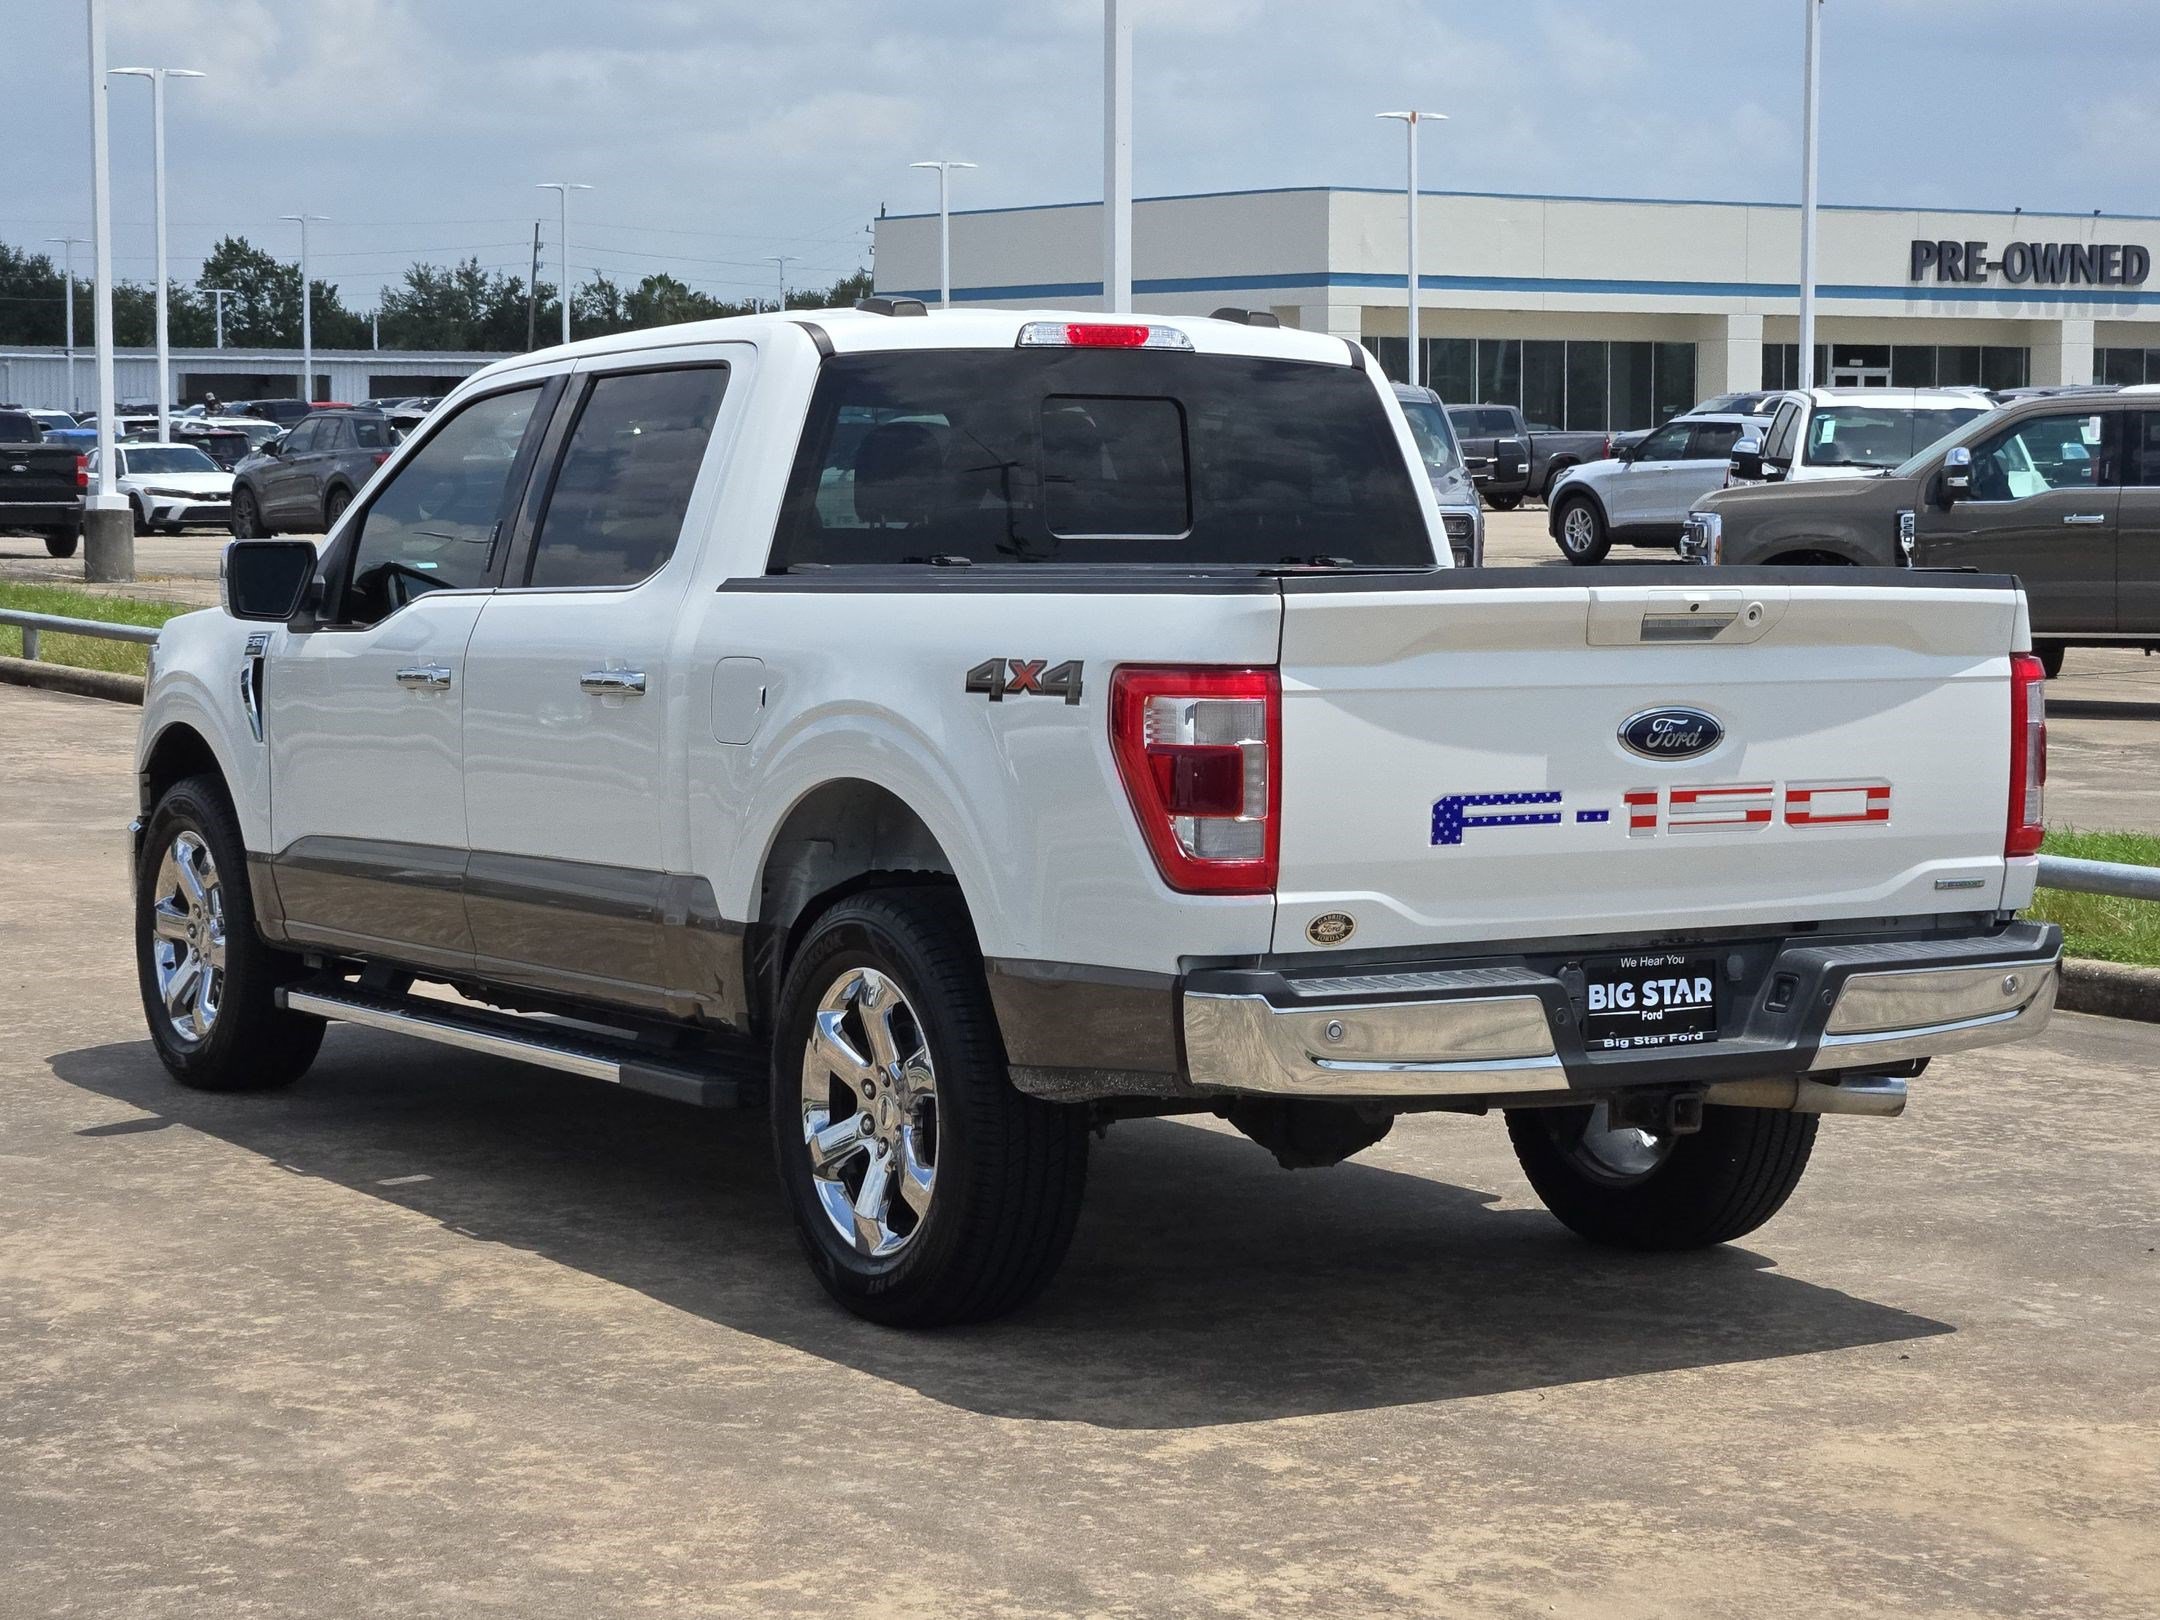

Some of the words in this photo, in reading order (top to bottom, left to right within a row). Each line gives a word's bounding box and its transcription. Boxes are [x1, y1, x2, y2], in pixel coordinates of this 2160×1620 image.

[1911, 240, 2150, 285] PRE-OWNED
[1646, 718, 1703, 748] Ford
[1429, 777, 1892, 846] F-150
[1320, 921, 1343, 933] Ford
[1620, 957, 1637, 968] We
[1640, 956, 1664, 967] Hear
[1666, 954, 1685, 965] You
[1588, 982, 1636, 1010] BIG
[1642, 977, 1713, 1007] STAR
[1641, 1009, 1663, 1021] Ford
[1603, 1038, 1630, 1048] Big
[1633, 1035, 1666, 1046] Star
[1669, 1031, 1704, 1043] Ford
